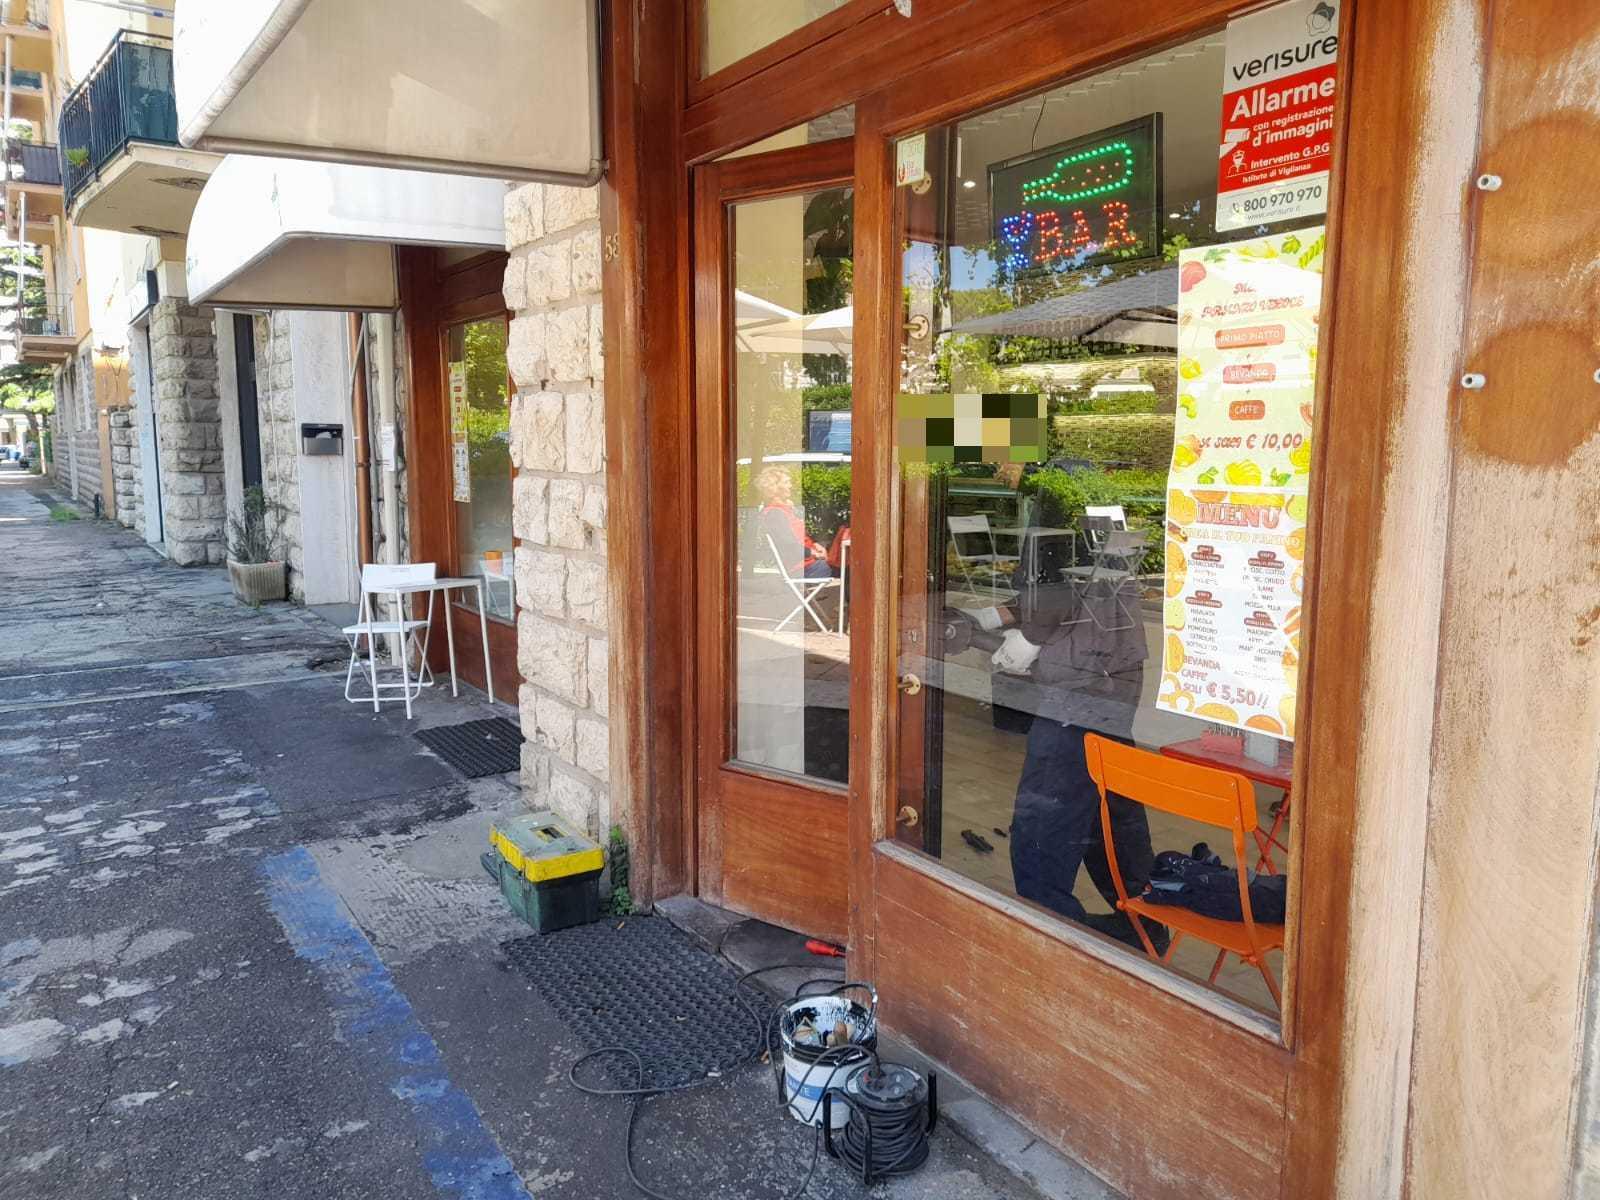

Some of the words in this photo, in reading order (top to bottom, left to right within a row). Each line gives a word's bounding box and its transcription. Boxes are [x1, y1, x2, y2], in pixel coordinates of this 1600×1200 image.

[1232, 35, 1338, 81] verisure
[1229, 76, 1336, 123] Allarme
[1252, 121, 1270, 132] con
[1271, 104, 1335, 128] registrazione
[1250, 151, 1300, 169] Intervento
[1269, 168, 1277, 178] di
[1243, 196, 1268, 213] 800
[1270, 191, 1294, 207] 970
[1296, 184, 1323, 201] 970
[1034, 201, 1137, 261] BAR
[1246, 433, 1257, 450] €
[1262, 433, 1303, 452] 10,00
[1183, 655, 1221, 671] BEVANDA
[1206, 681, 1218, 698] €
[1221, 684, 1270, 710] 5,50!!
